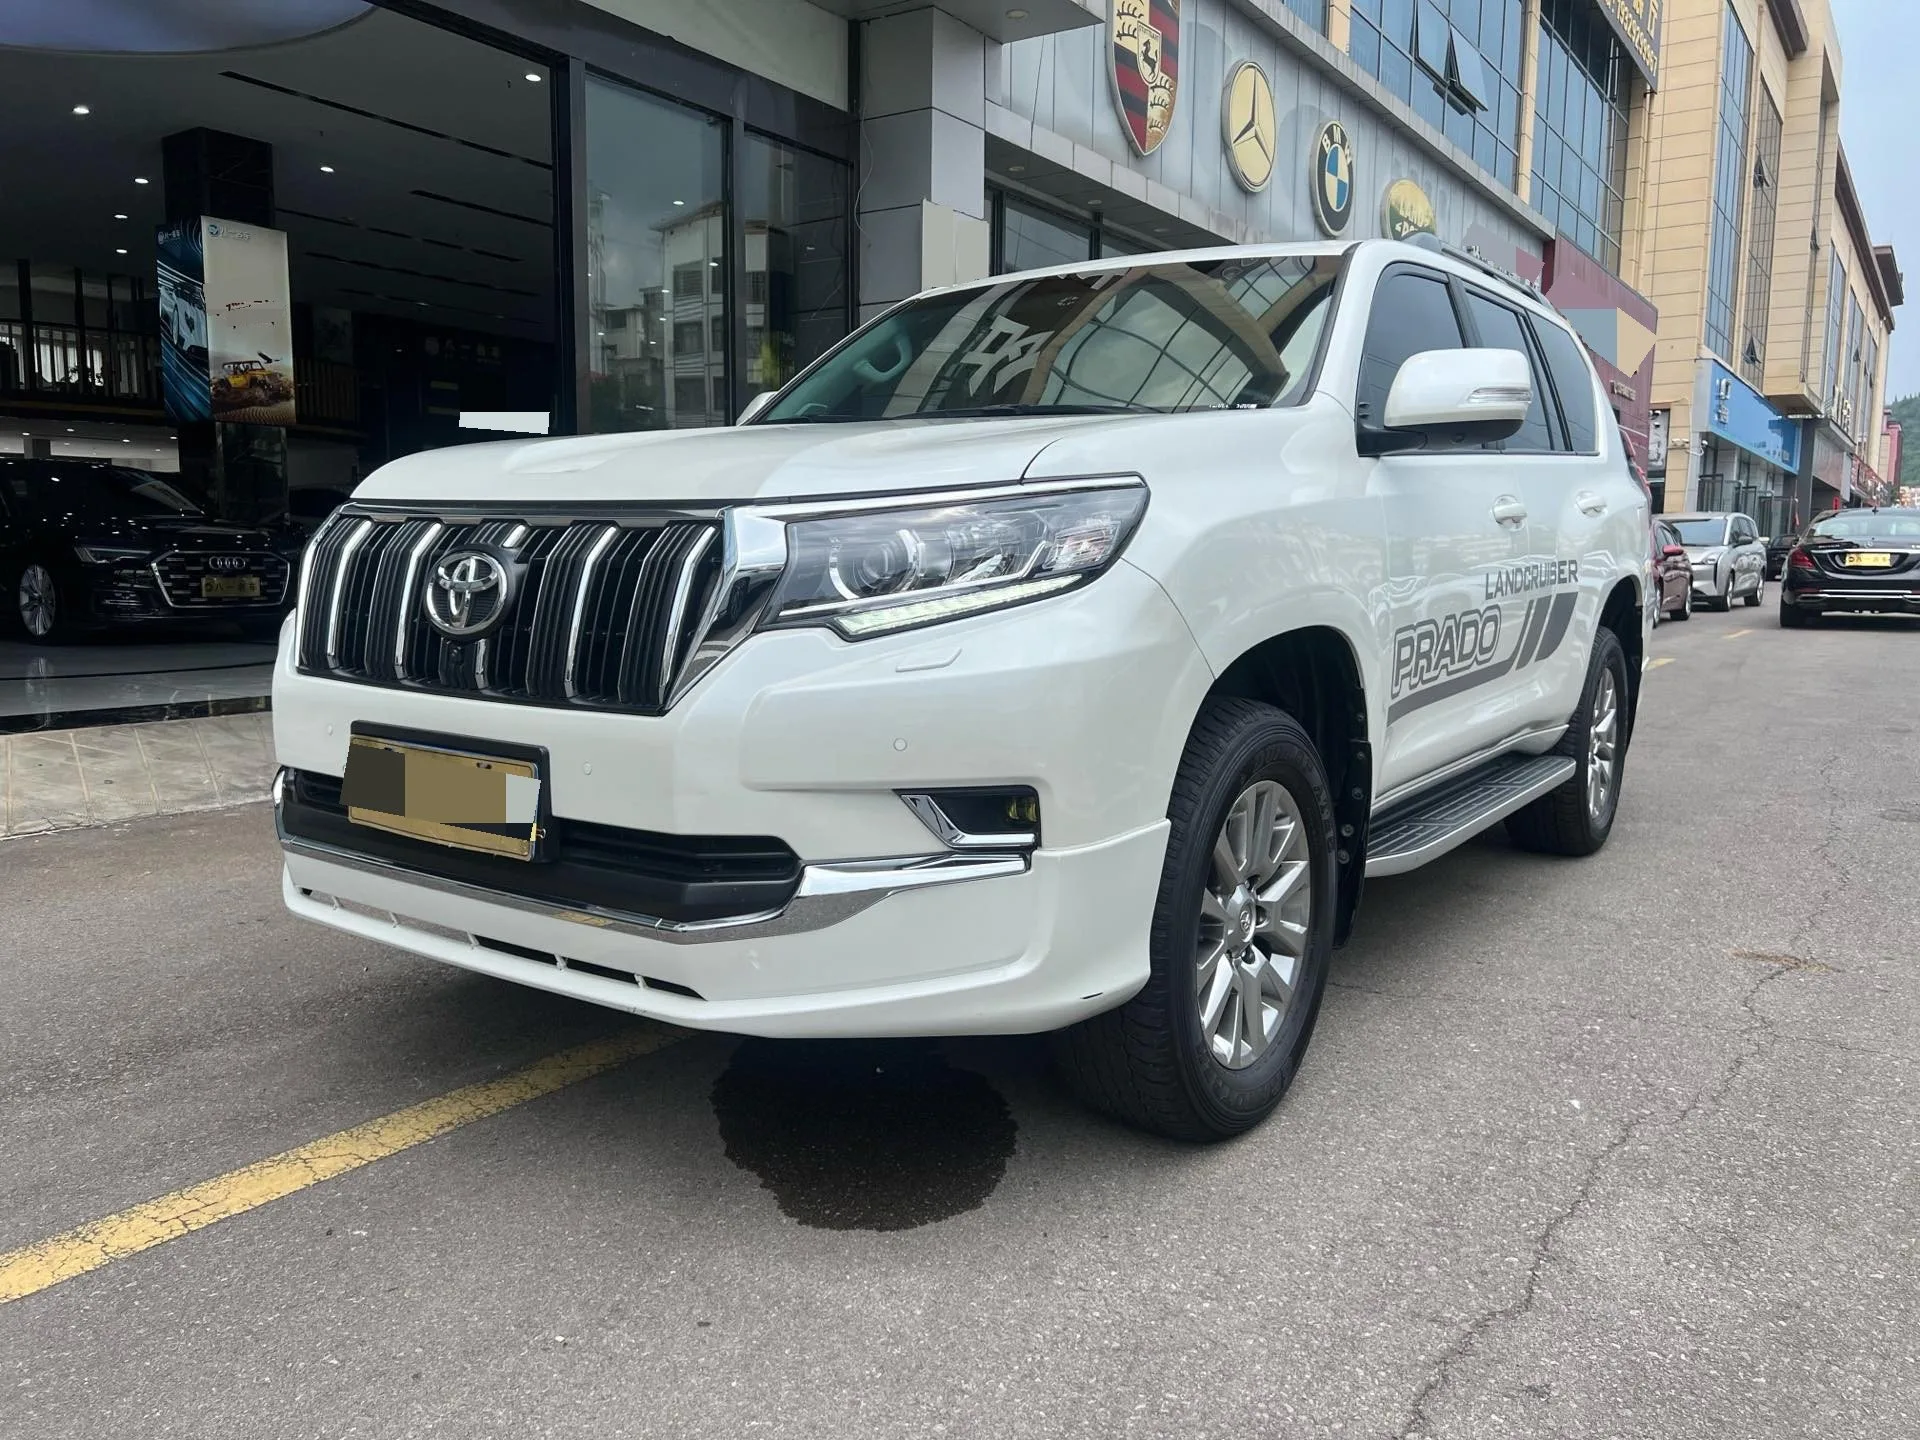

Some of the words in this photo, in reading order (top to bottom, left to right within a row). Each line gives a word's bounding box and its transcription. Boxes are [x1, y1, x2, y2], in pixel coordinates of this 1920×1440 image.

[1322, 125, 1352, 165] BMW
[1485, 559, 1578, 600] LANDCRUISER
[1391, 603, 1502, 699] PRADO
